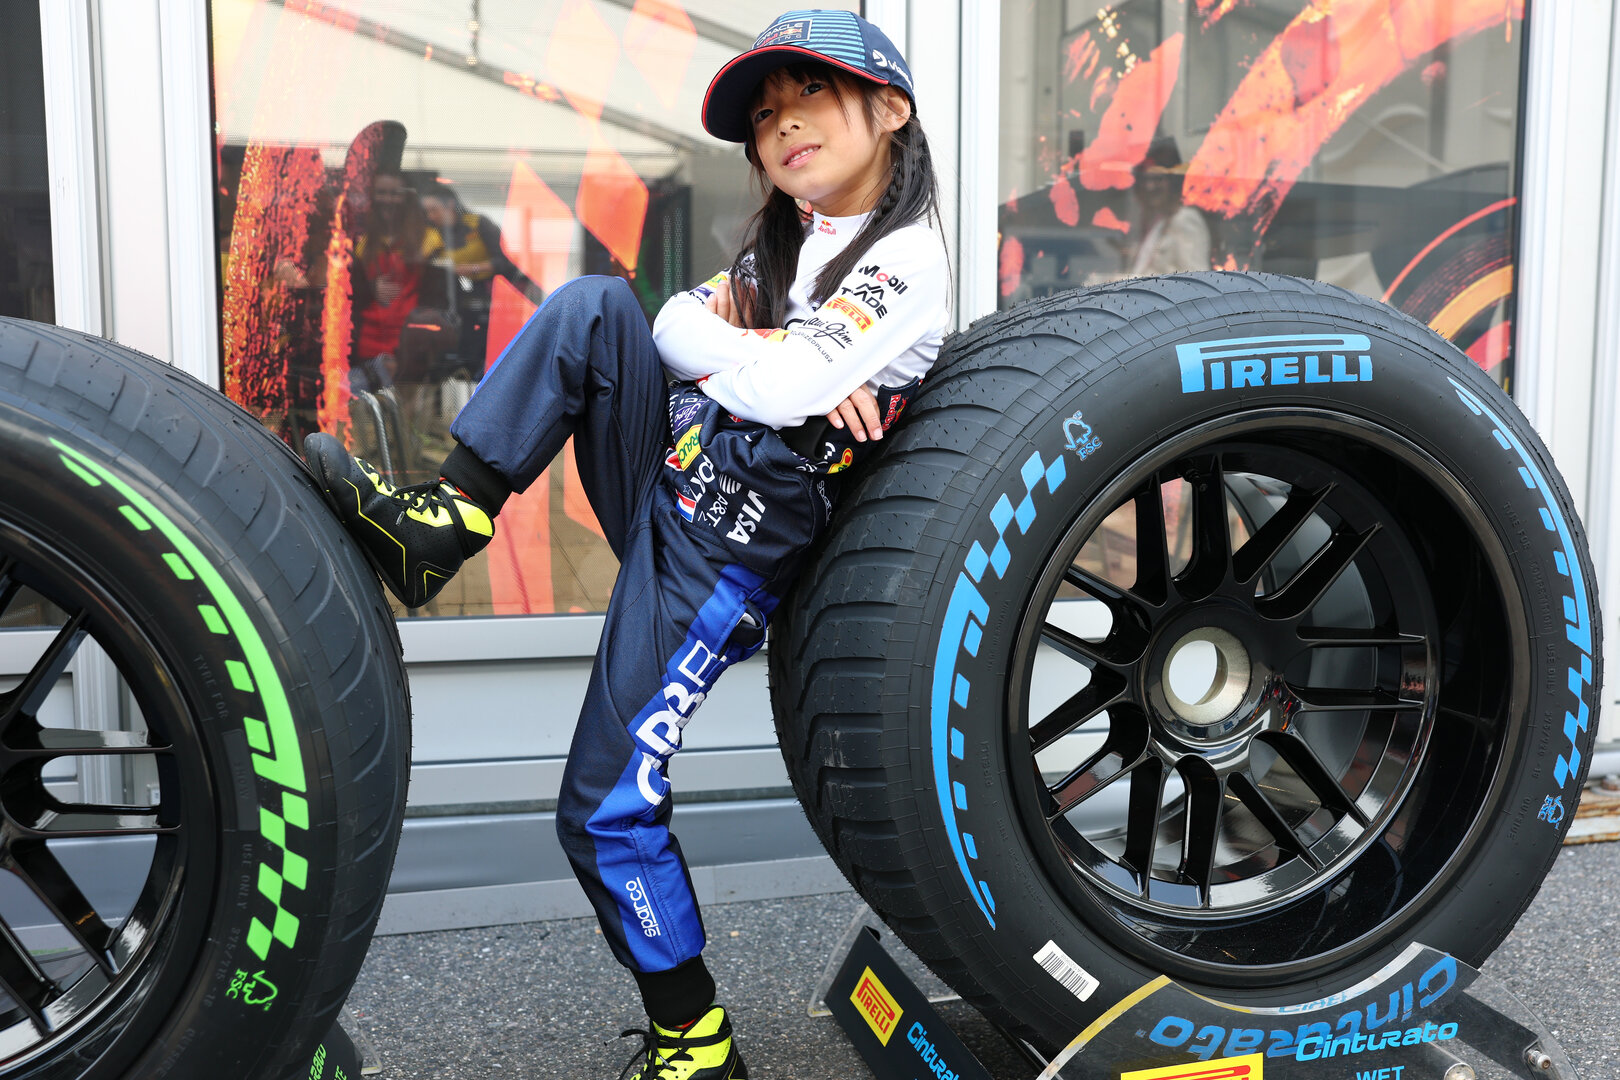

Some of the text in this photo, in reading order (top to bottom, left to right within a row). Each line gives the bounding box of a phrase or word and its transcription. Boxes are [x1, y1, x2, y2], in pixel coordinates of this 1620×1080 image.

[757, 22, 804, 47] ORACLE
[858, 264, 908, 295] Mobil
[1175, 334, 1373, 394] PIRELLI
[1076, 436, 1103, 462] FSC
[726, 490, 766, 545] VISA
[193, 655, 217, 689] TYRE
[211, 690, 230, 719] FOR
[1536, 795, 1554, 822] FSC
[626, 877, 661, 938] sparco
[225, 968, 249, 1000] FSC
[857, 977, 896, 1034] PIRELLI
[1296, 1022, 1459, 1062] Cinturato
